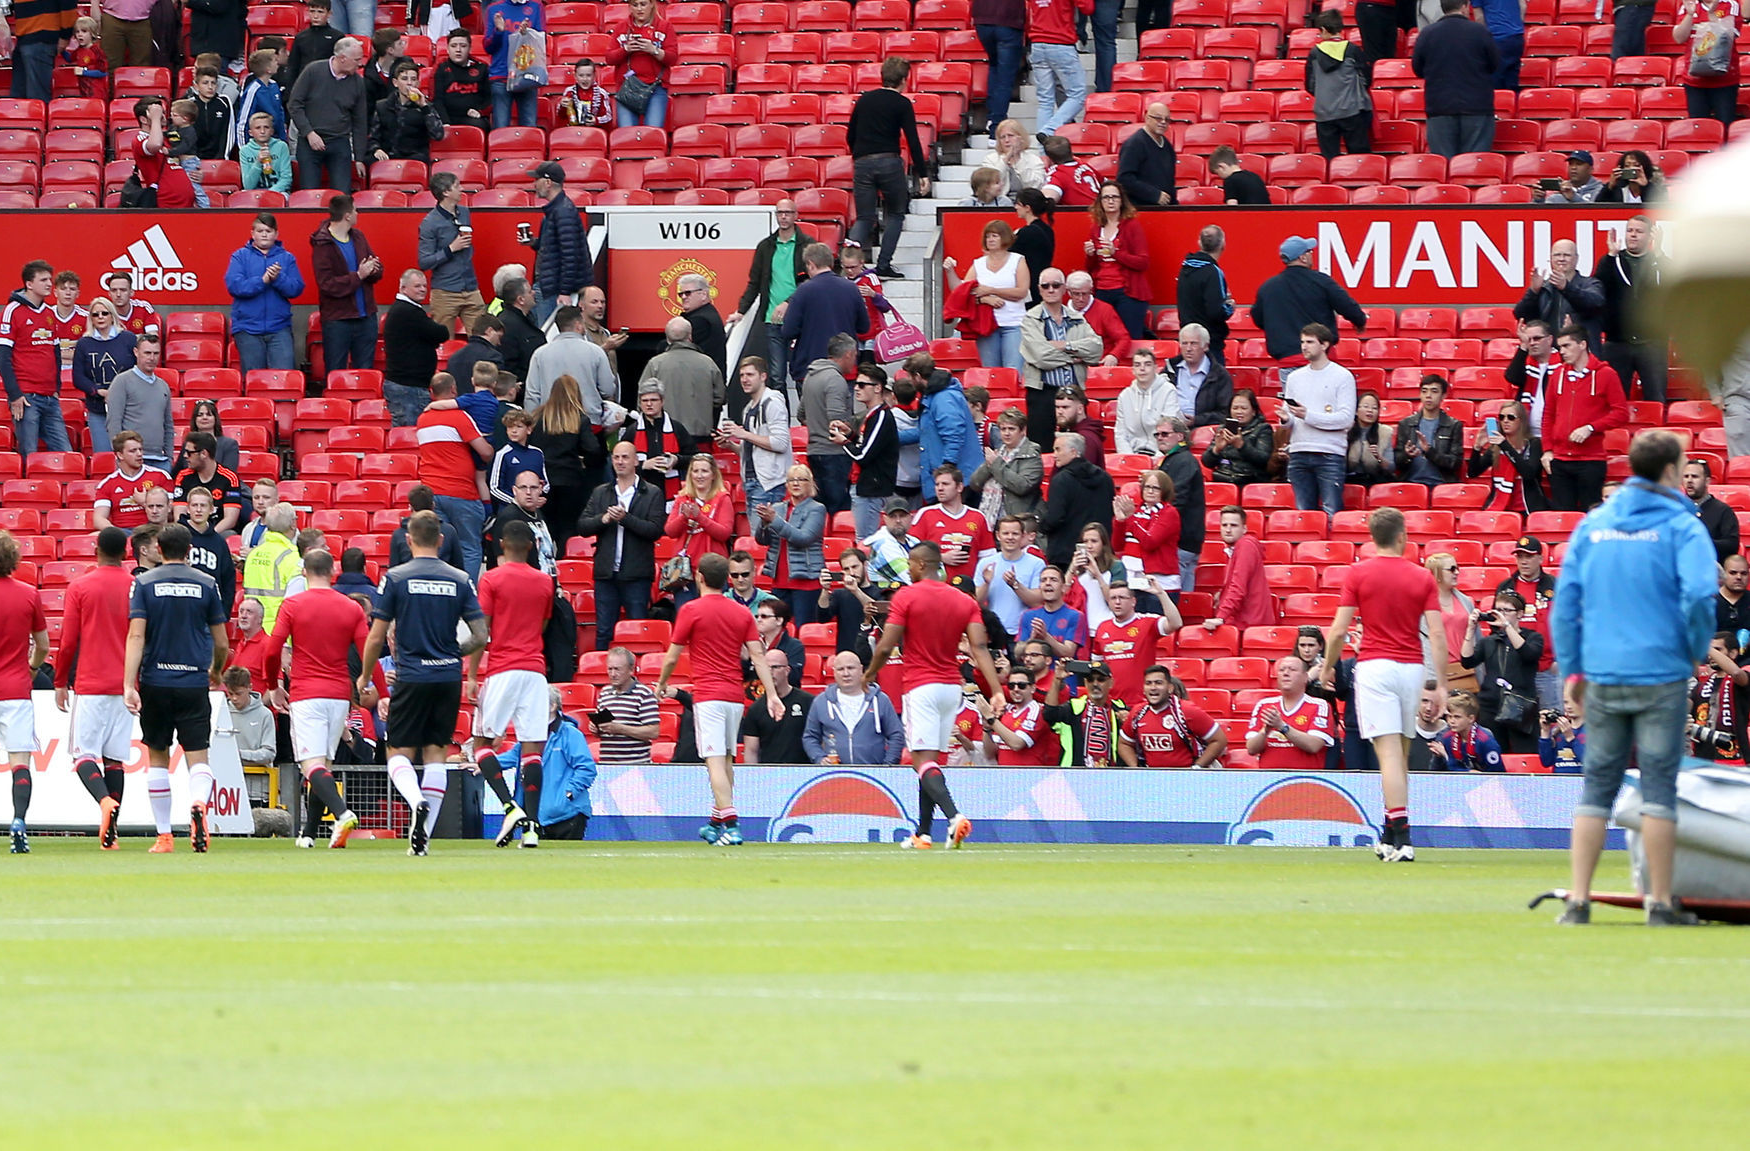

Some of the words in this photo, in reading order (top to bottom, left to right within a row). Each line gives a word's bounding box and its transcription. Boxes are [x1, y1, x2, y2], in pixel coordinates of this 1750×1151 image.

[659, 222, 721, 240] W106
[662, 262, 715, 284] MANCHESTER
[887, 344, 914, 357] adidas
[155, 583, 202, 598] carbrini
[410, 579, 456, 596] carbrini
[1144, 735, 1171, 749] AIG
[207, 780, 241, 816] AON
